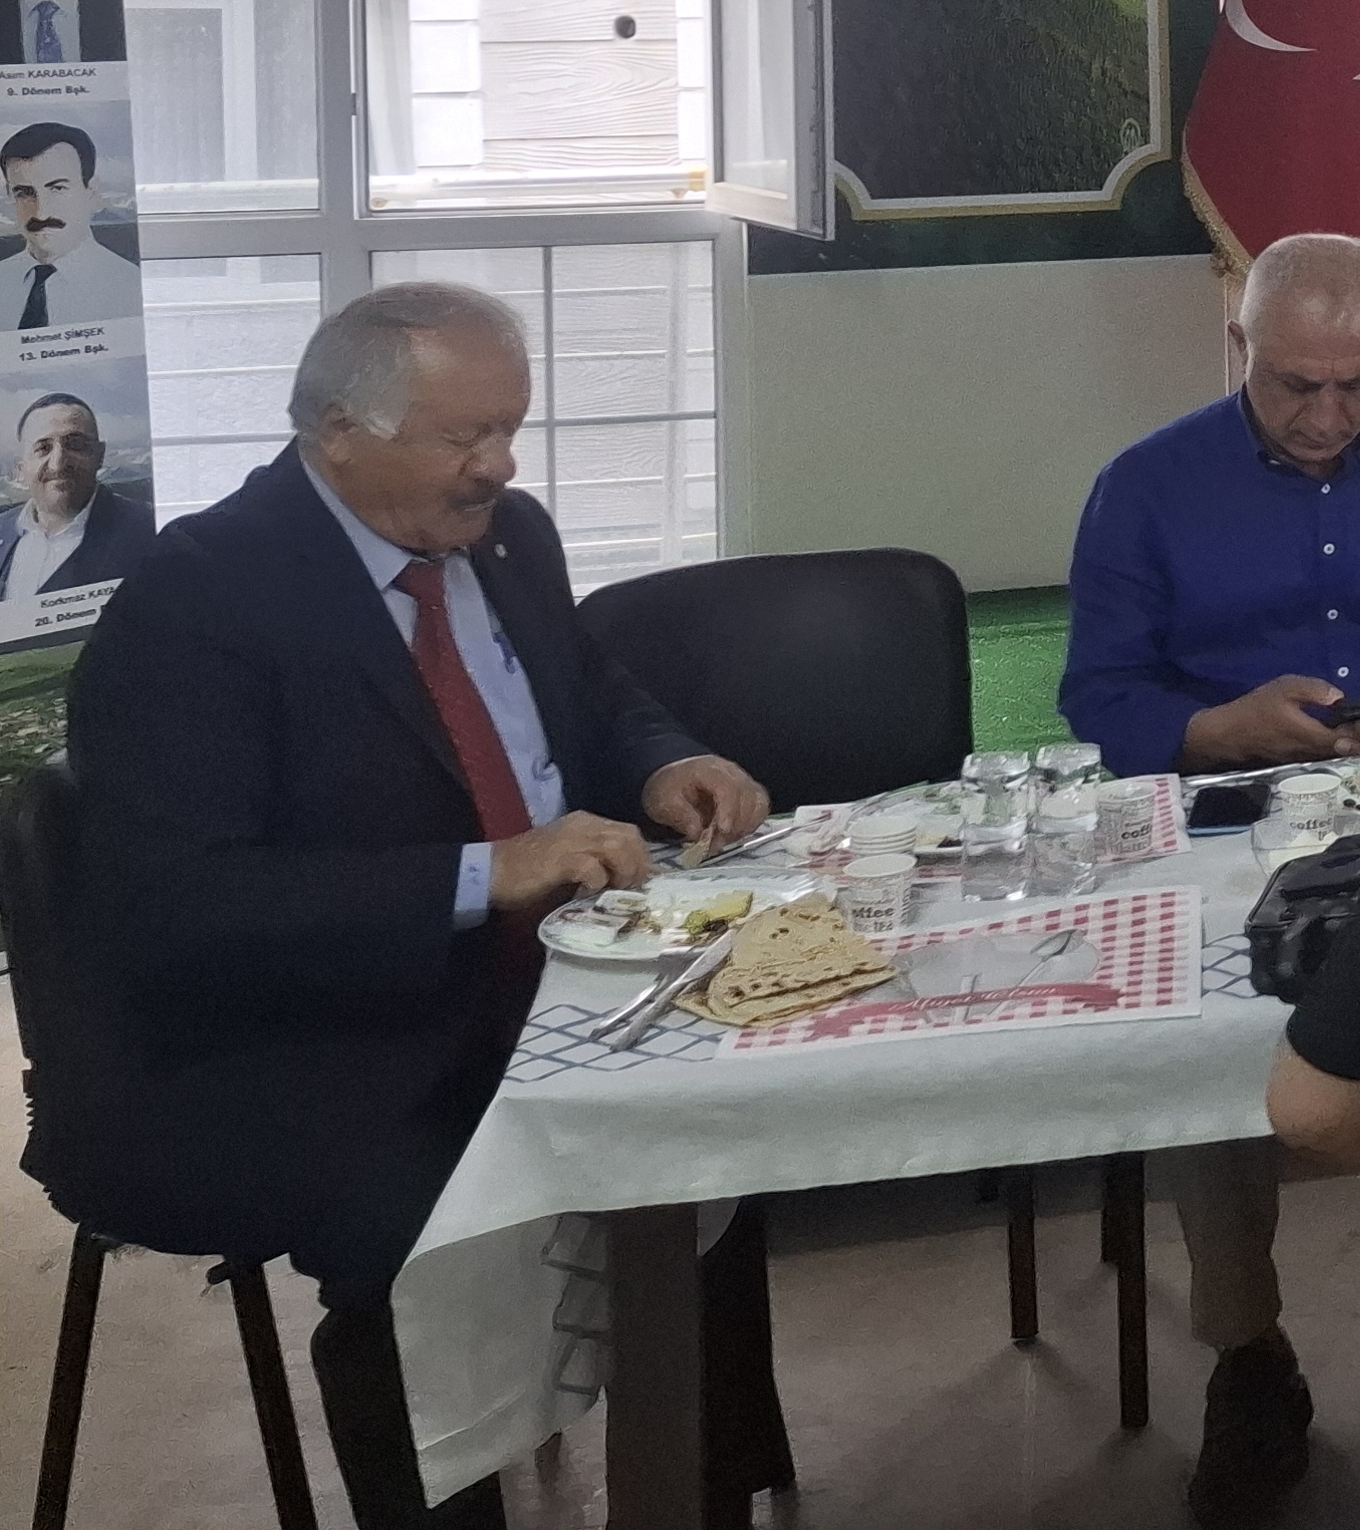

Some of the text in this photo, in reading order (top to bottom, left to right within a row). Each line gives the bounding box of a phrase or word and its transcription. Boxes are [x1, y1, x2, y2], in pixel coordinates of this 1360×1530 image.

[27, 68, 97, 79] KARABACAK
[22, 86, 62, 96] Dönem
[21, 327, 105, 345] Mehmet ŞİMŞEK
[41, 348, 80, 359] Dönem
[56, 608, 97, 623] Dönem
